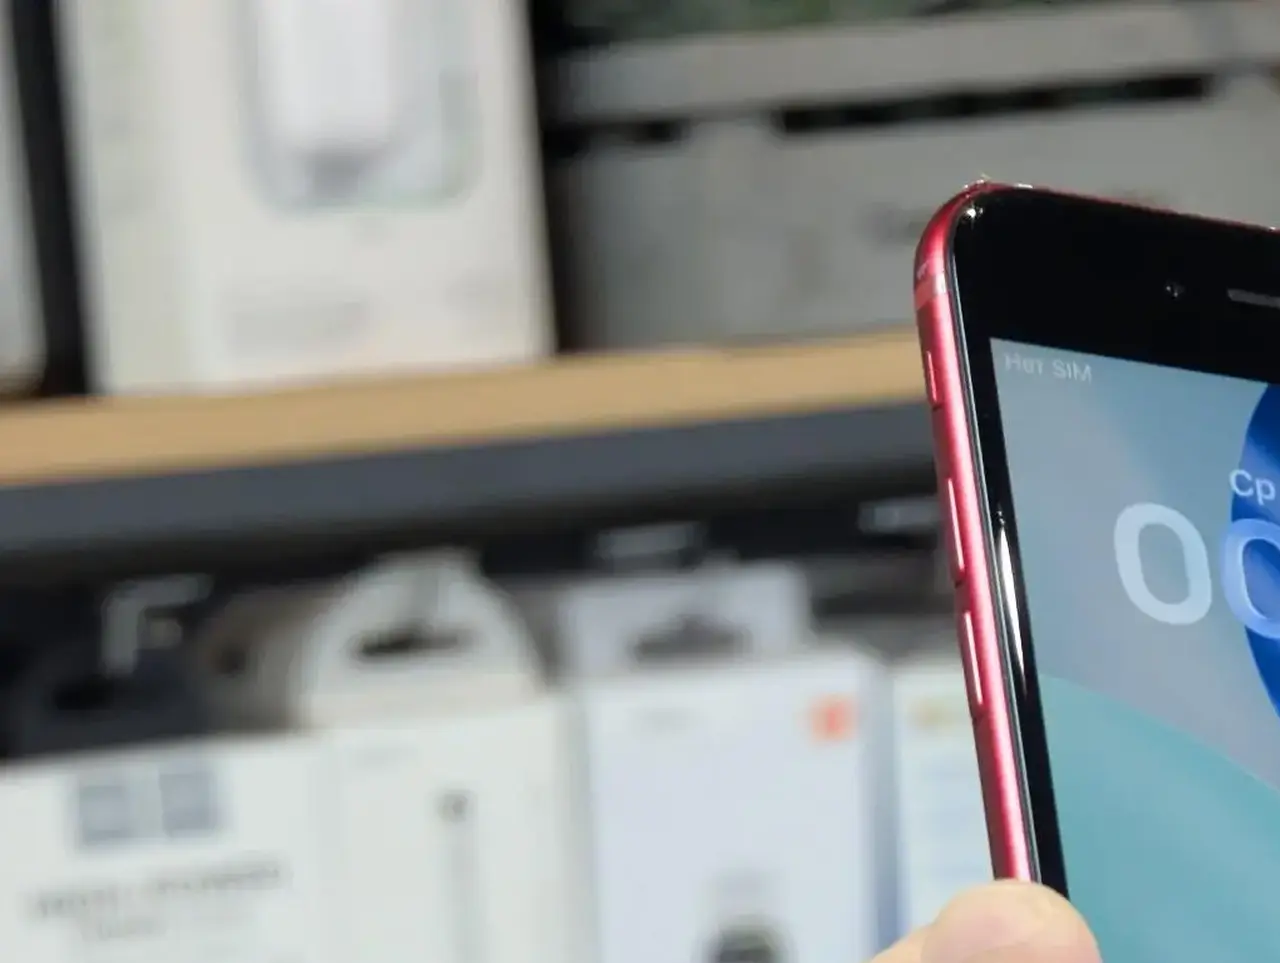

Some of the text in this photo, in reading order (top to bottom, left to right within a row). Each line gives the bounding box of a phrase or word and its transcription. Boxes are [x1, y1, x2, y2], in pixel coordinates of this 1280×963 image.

[1004, 352, 1092, 385] Нет SIM
[1229, 468, 1276, 506] Ср
